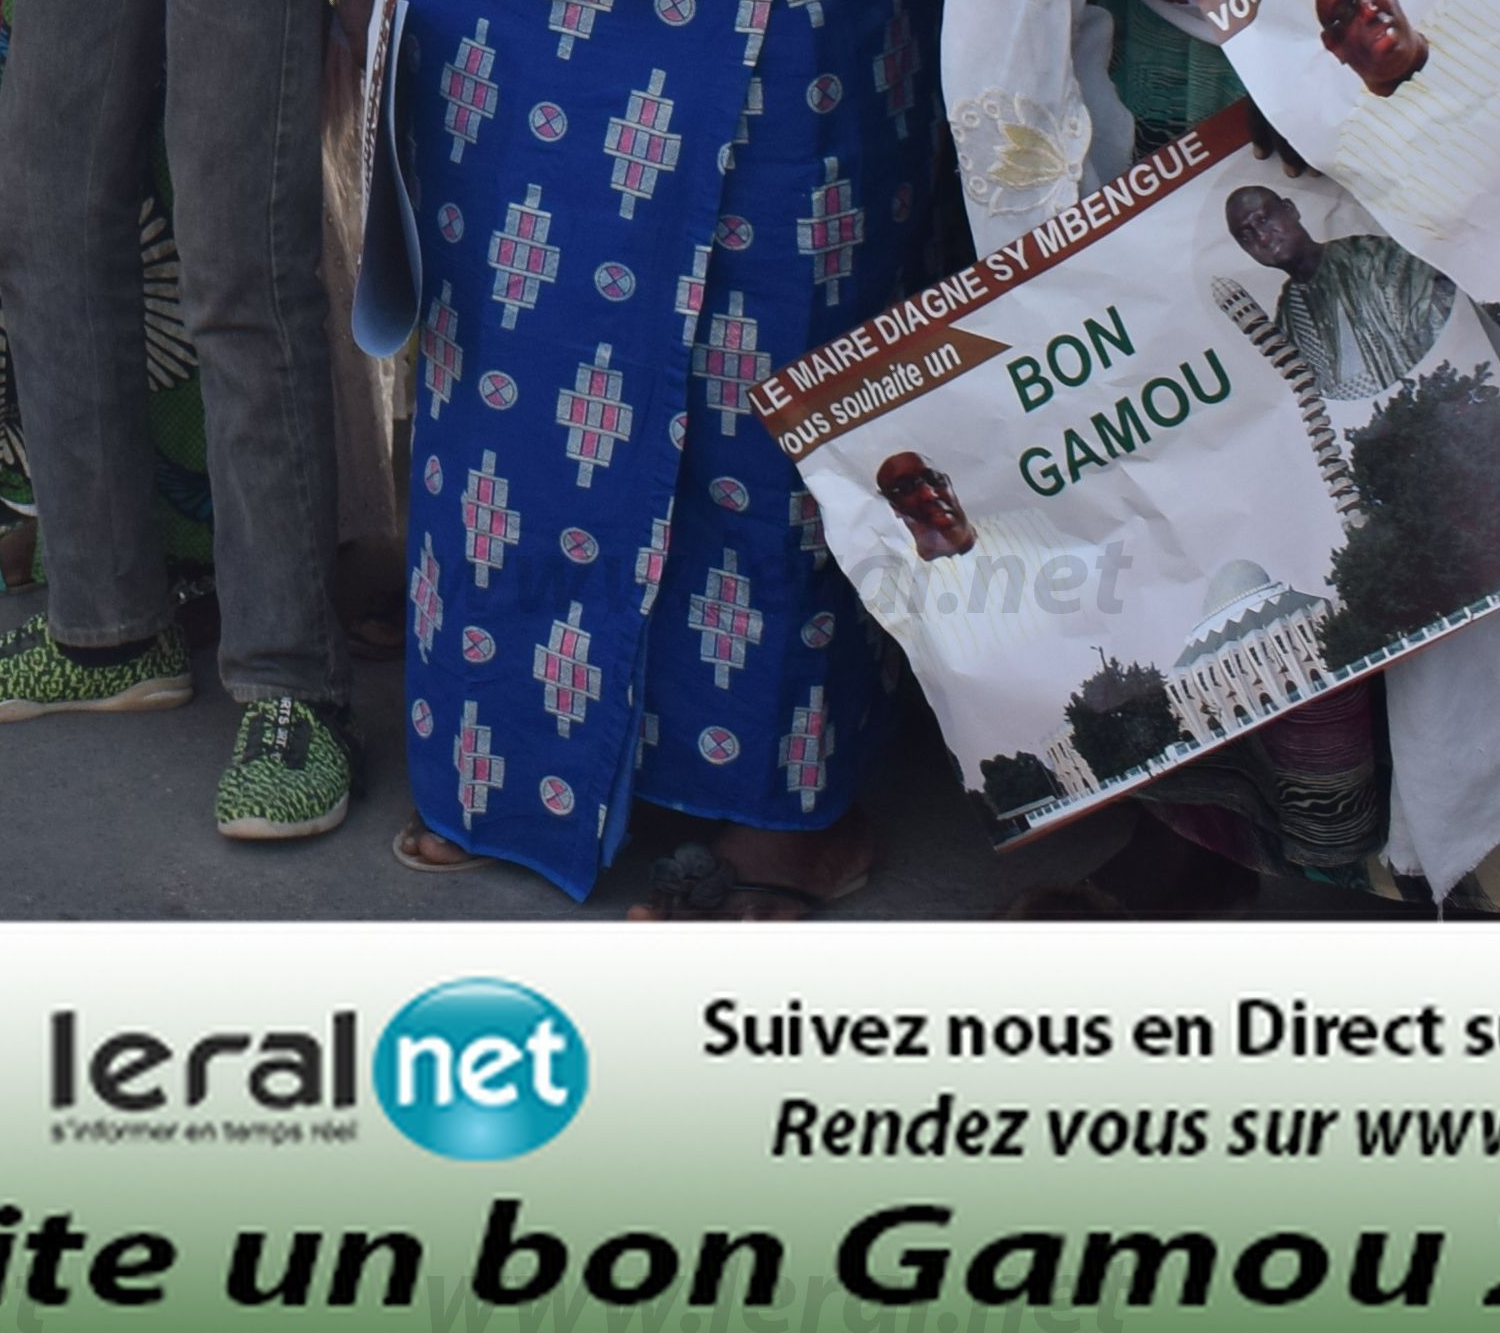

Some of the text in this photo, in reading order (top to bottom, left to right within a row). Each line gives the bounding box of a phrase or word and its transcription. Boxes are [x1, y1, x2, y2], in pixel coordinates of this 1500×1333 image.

[749, 130, 1211, 417] LE MAIRE DIAGNE SY MBENGUE
[830, 361, 925, 425] souhaite
[924, 342, 962, 378] un
[1006, 305, 1136, 414] BON
[1018, 347, 1232, 497] GAMOU
